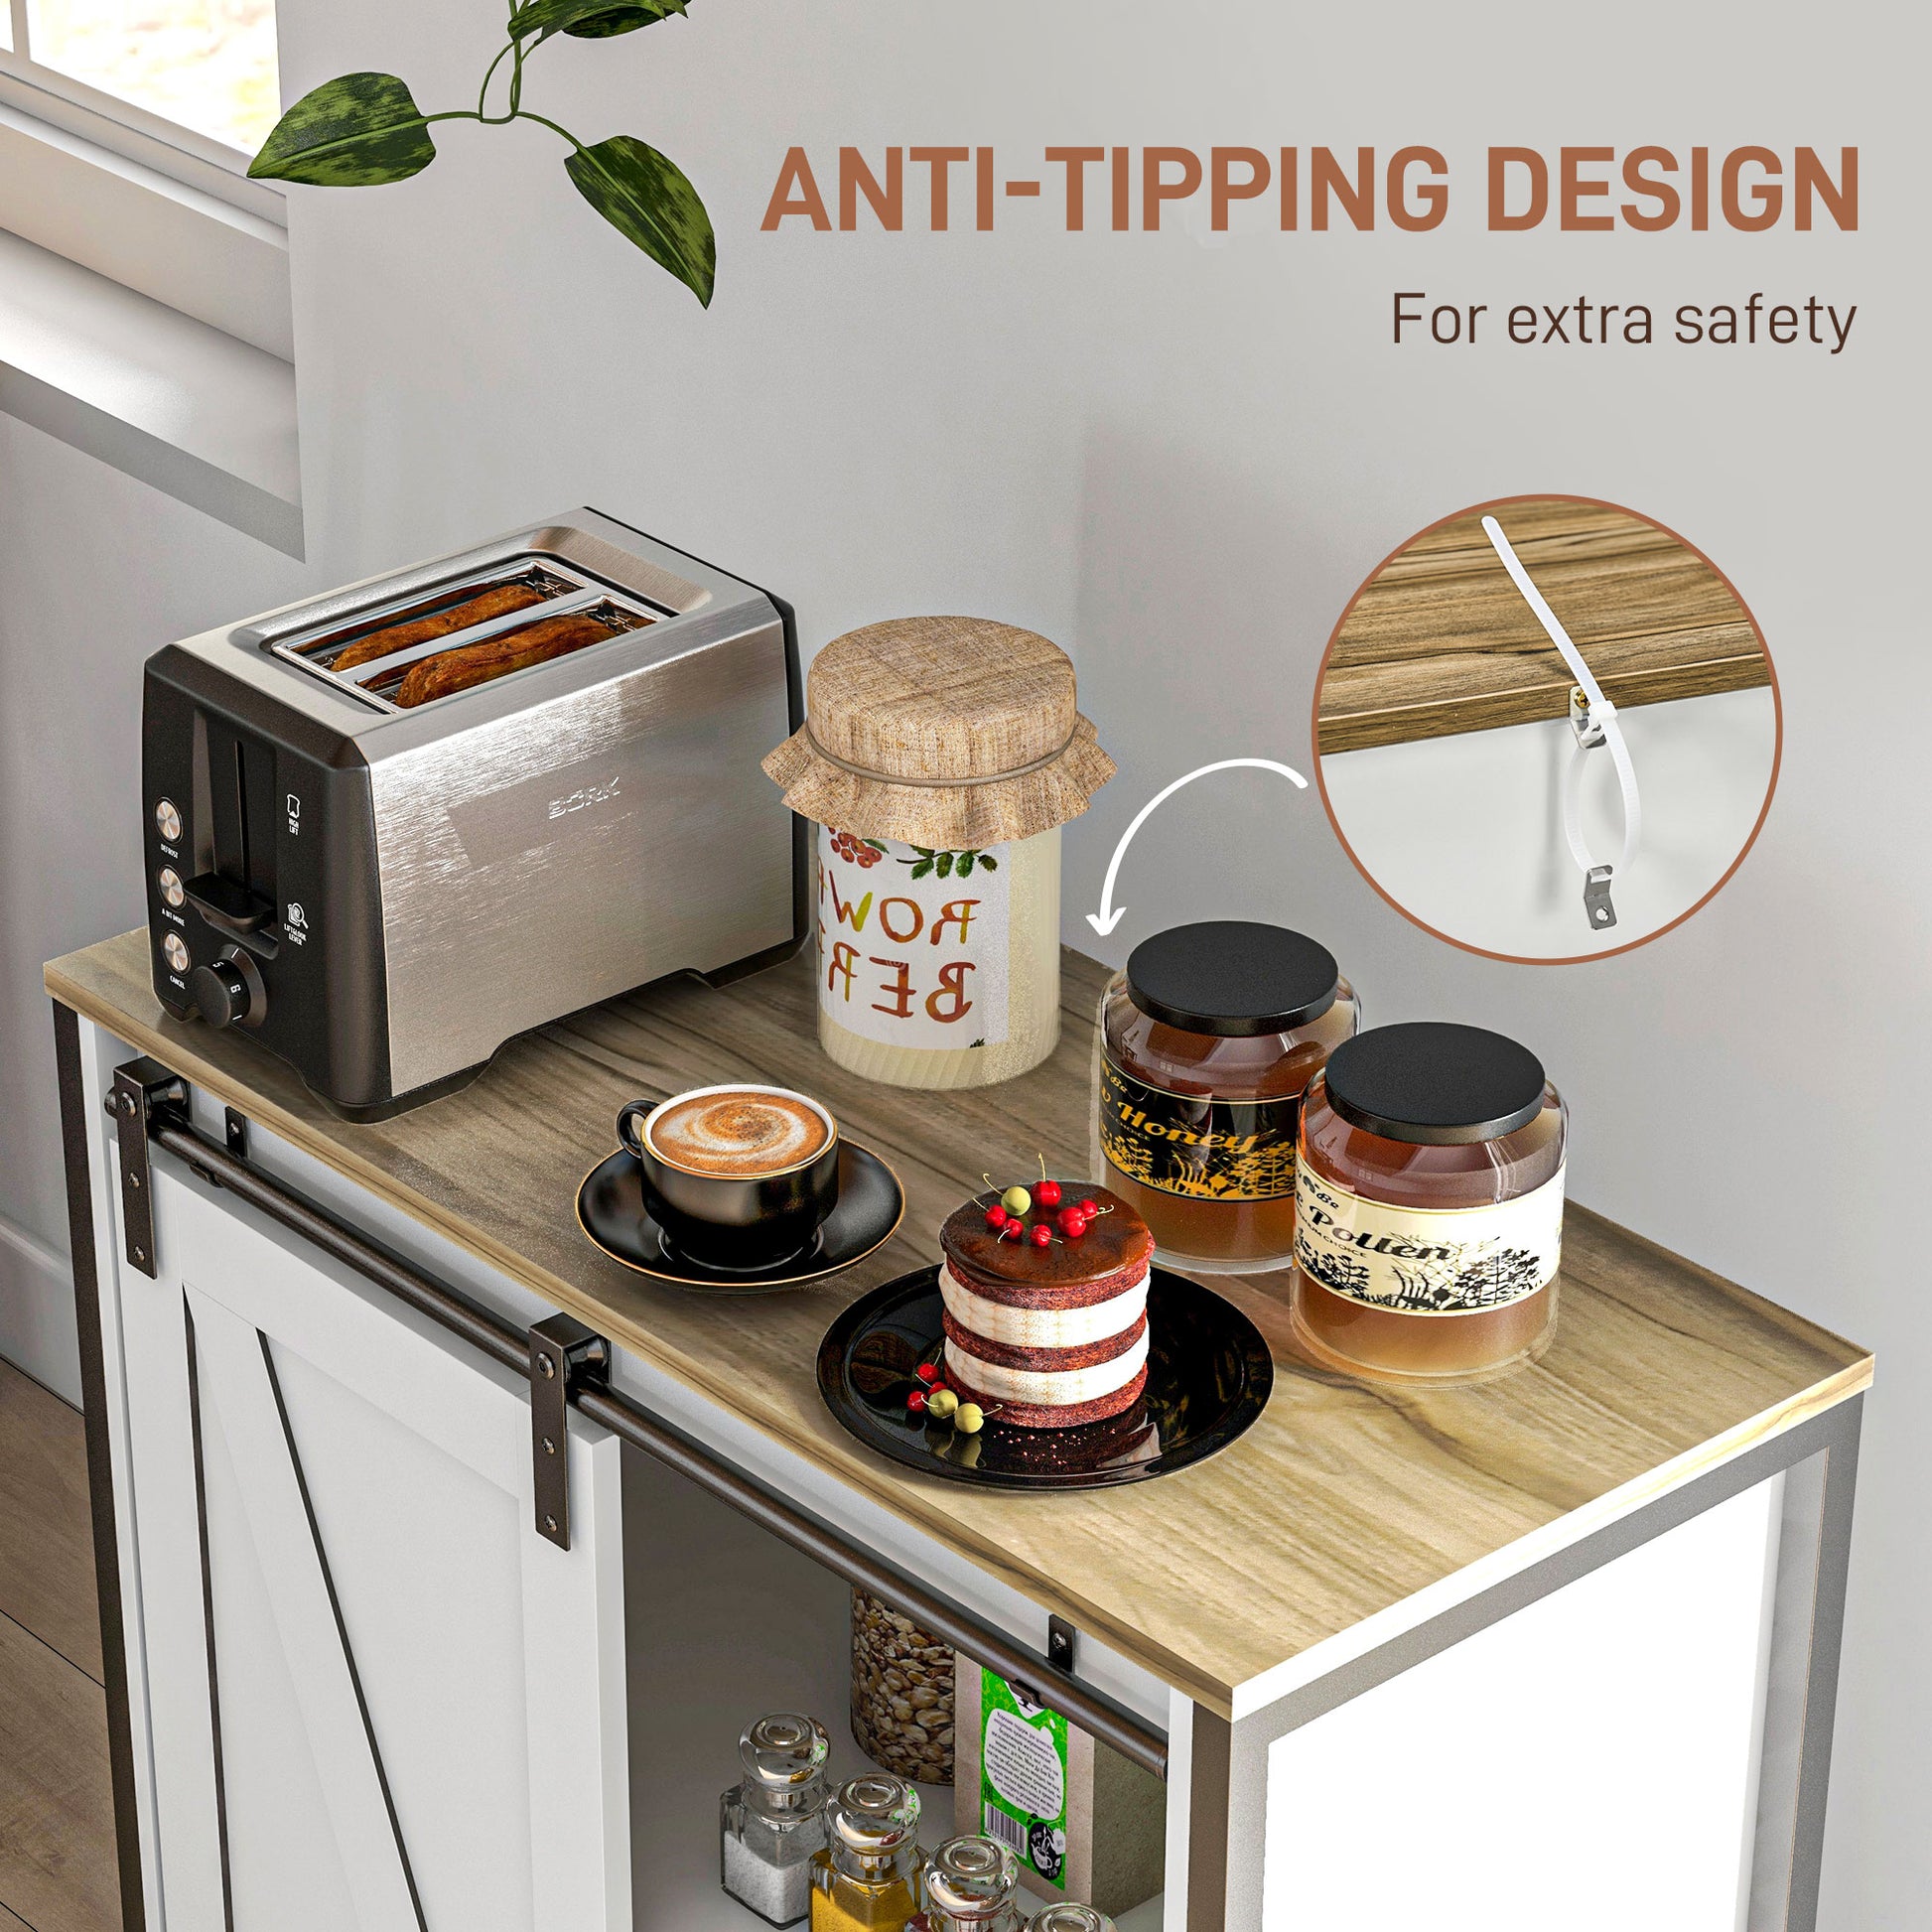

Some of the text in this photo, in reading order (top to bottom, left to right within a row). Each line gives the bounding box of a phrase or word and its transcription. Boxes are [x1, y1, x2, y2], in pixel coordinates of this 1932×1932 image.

[169, 975, 186, 989] CANCEL
[1117, 1101, 1260, 1155] Honey
[1309, 1204, 1449, 1261] Pollen
